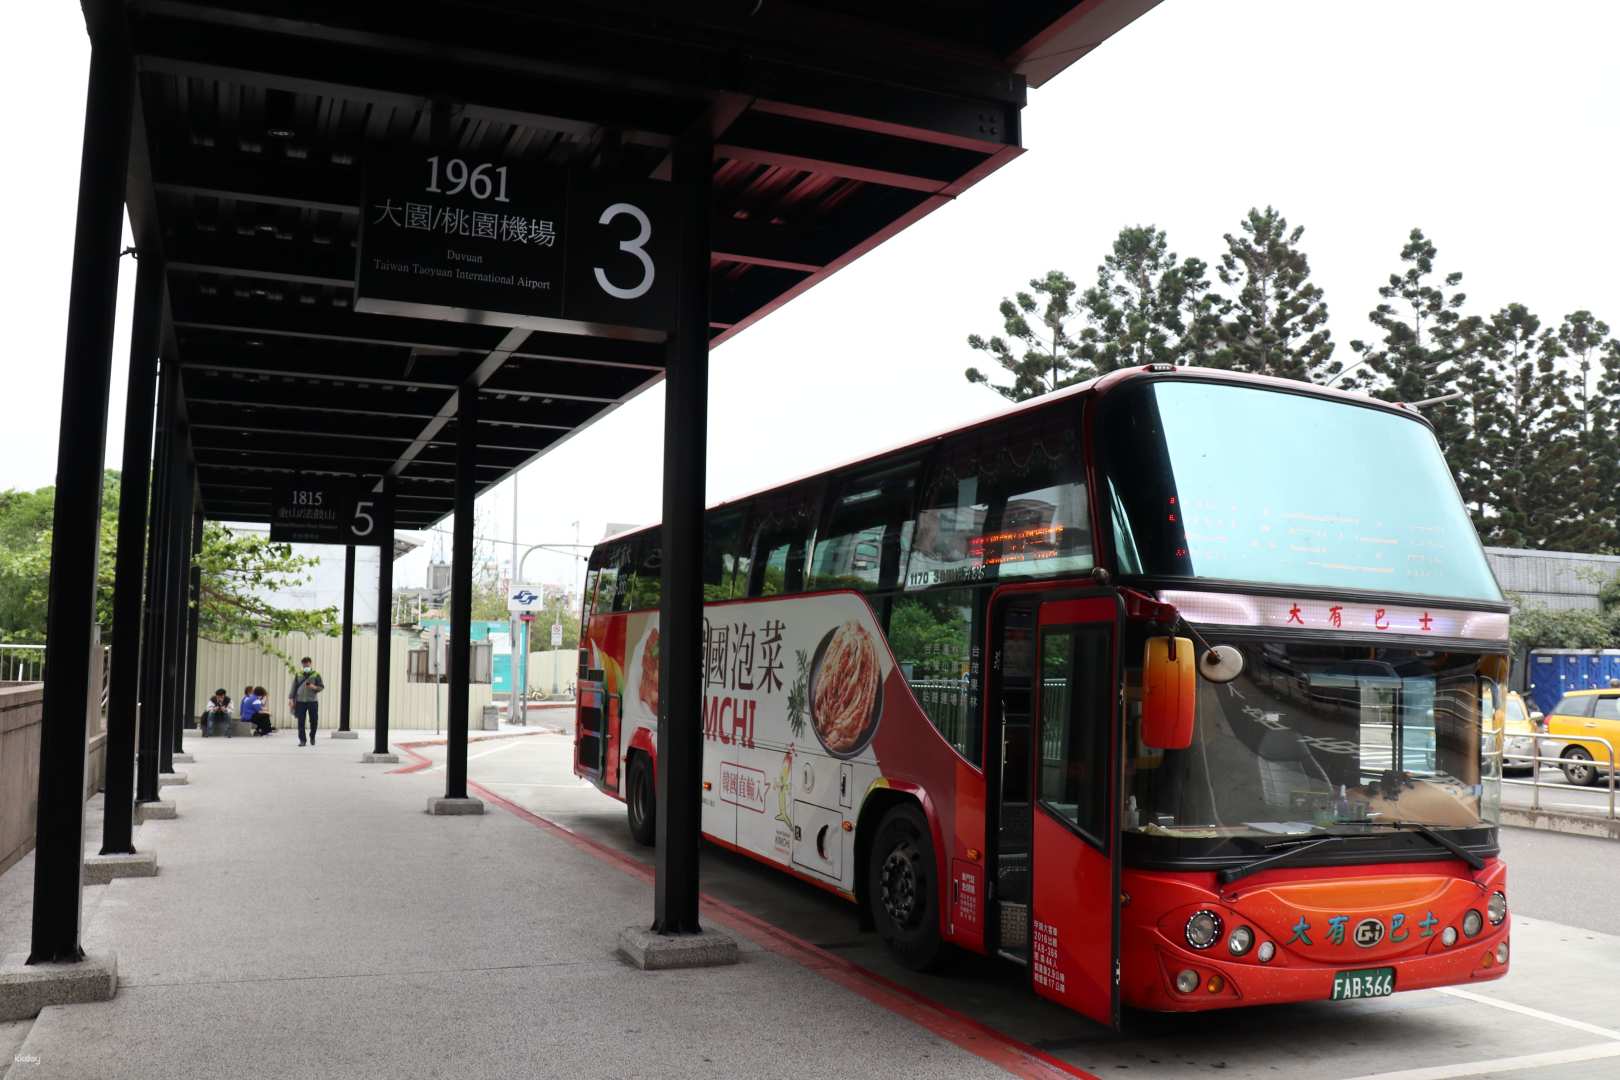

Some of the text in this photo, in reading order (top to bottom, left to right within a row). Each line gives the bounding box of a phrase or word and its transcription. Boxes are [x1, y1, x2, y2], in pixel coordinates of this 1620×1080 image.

[425, 155, 511, 203] 1961
[373, 198, 557, 248] 大園/桃園機場
[373, 258, 551, 291] Taiwan Taoyuan International Airport
[593, 202, 655, 300] 3
[291, 490, 322, 506] 1815
[350, 501, 374, 537] 5
[1287, 602, 1434, 631] 大有巴士
[702, 617, 786, 694] 國泡菜
[703, 695, 757, 750] MCHI
